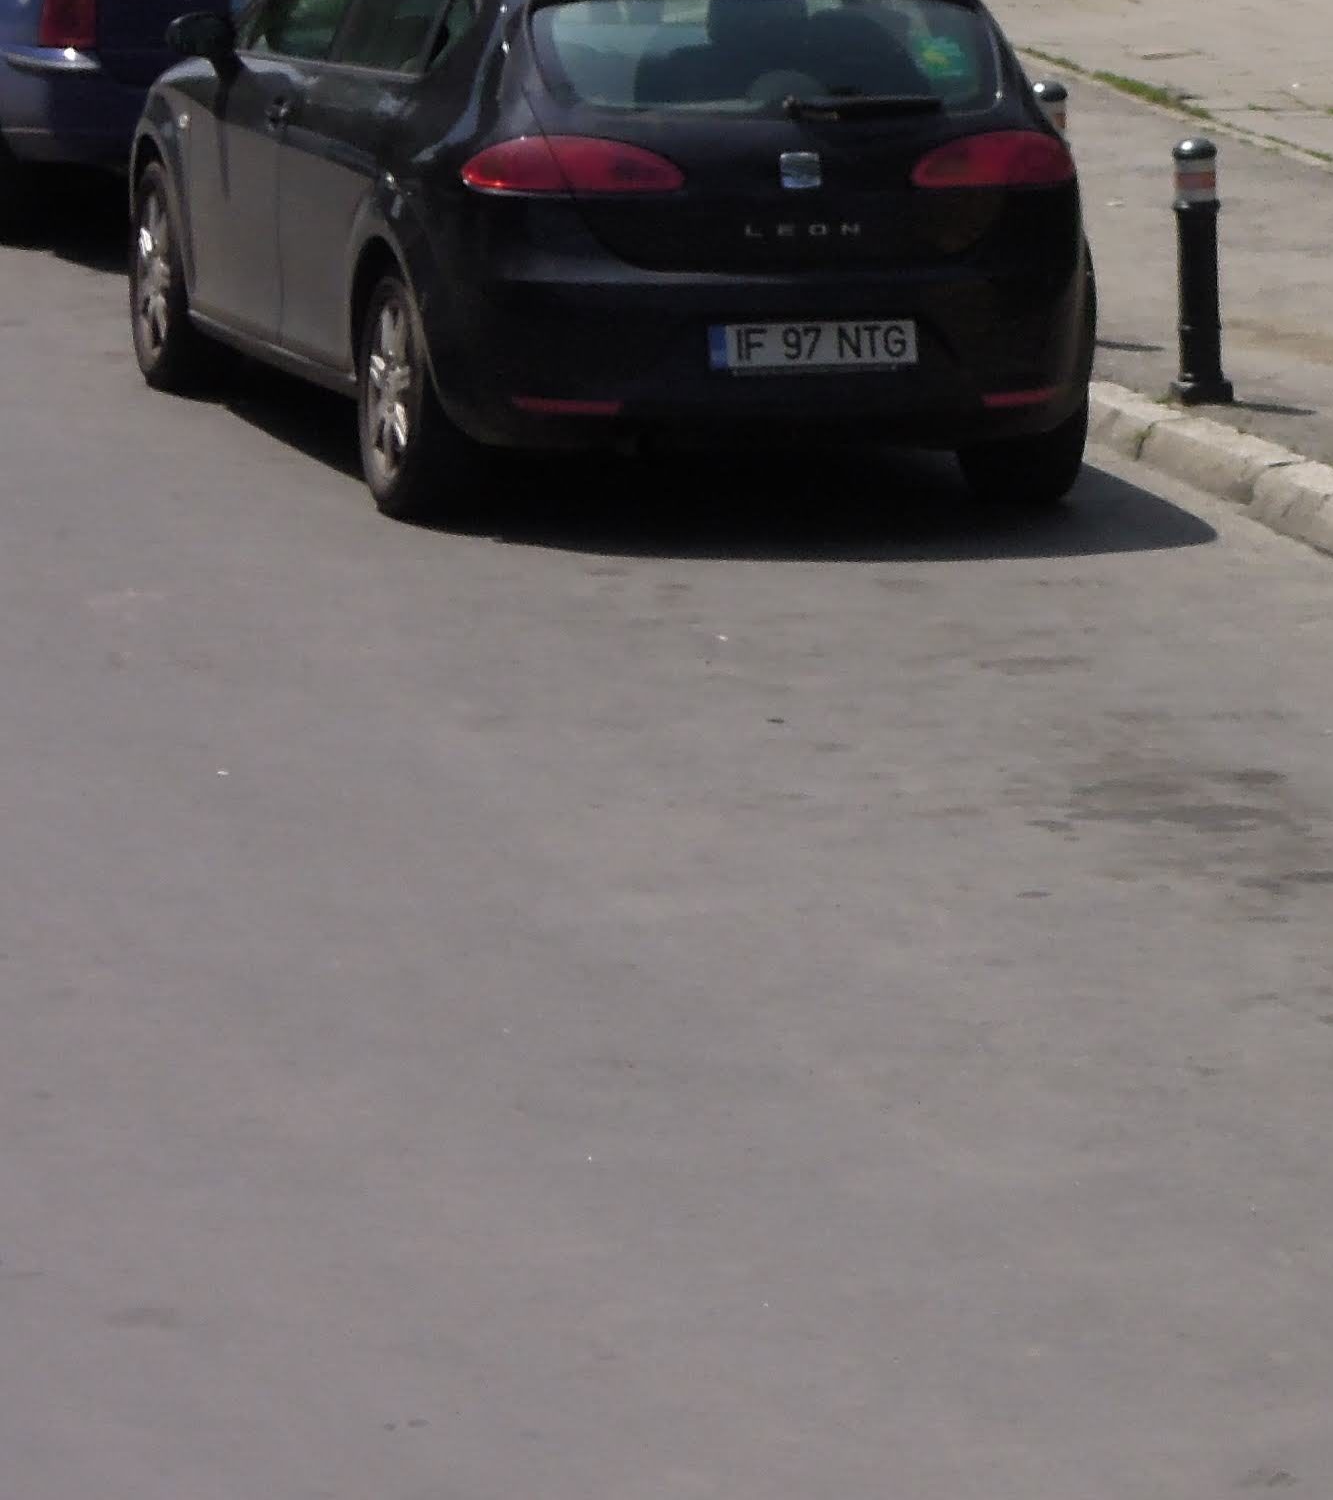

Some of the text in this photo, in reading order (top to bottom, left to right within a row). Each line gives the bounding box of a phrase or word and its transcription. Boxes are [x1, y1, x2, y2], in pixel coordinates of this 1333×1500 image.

[744, 223, 862, 238] LEON
[736, 324, 908, 362] IF 97 NTG
